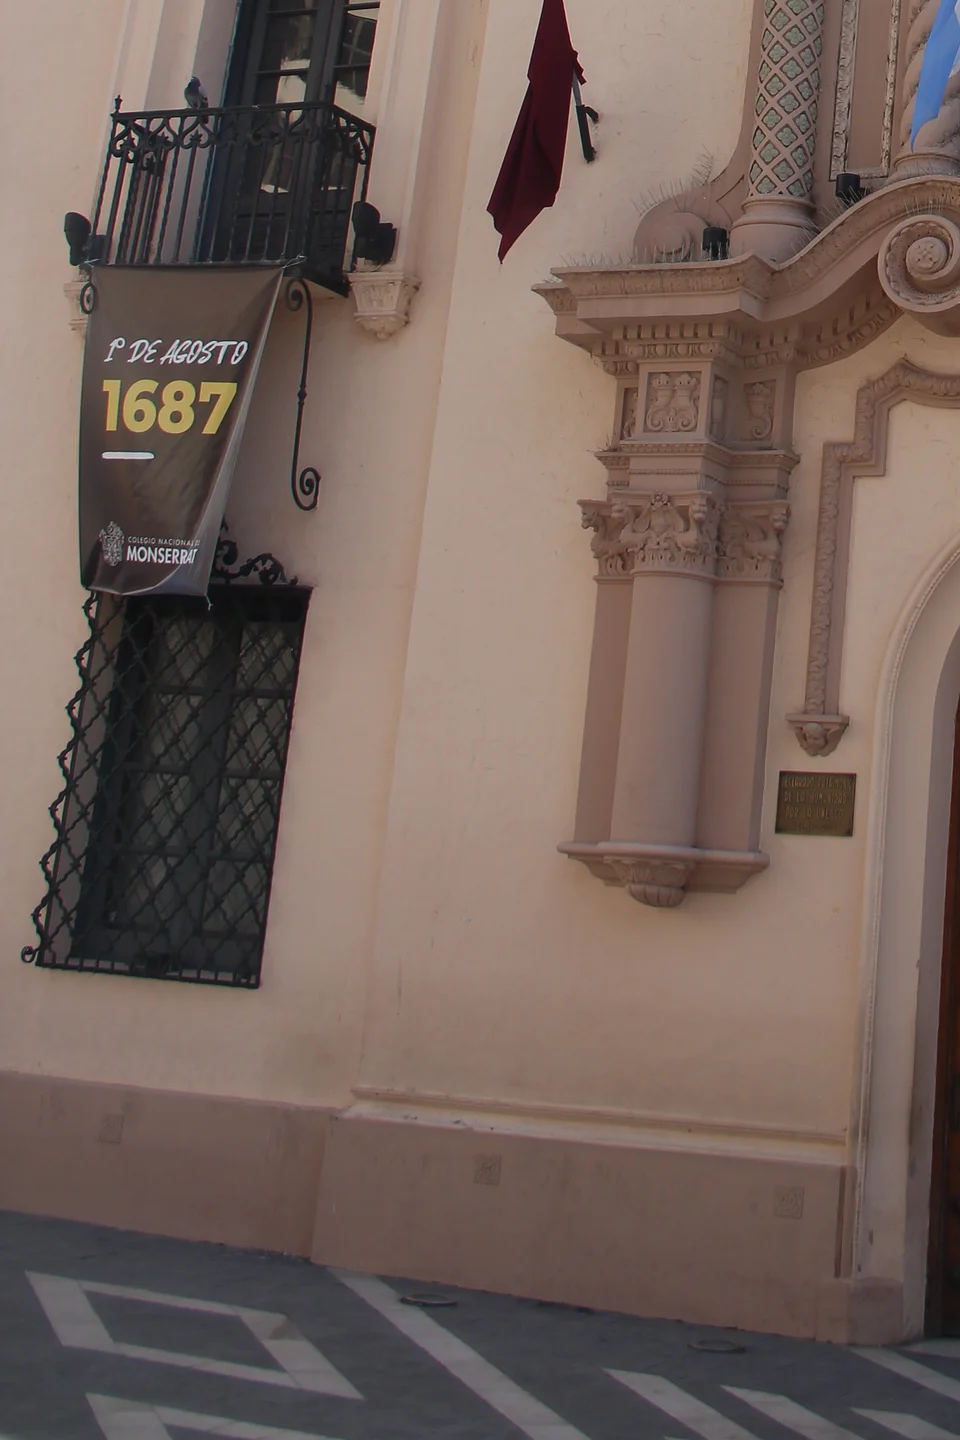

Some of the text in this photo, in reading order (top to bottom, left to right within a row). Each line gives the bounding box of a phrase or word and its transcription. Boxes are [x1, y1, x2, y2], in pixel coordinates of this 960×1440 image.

[127, 339, 162, 363] DE
[160, 339, 248, 365] AGOSTO
[102, 379, 238, 435] 1687
[128, 536, 156, 545] COLEGIO
[158, 538, 193, 546] NACIONAL
[127, 545, 199, 565] MONSERRAT
